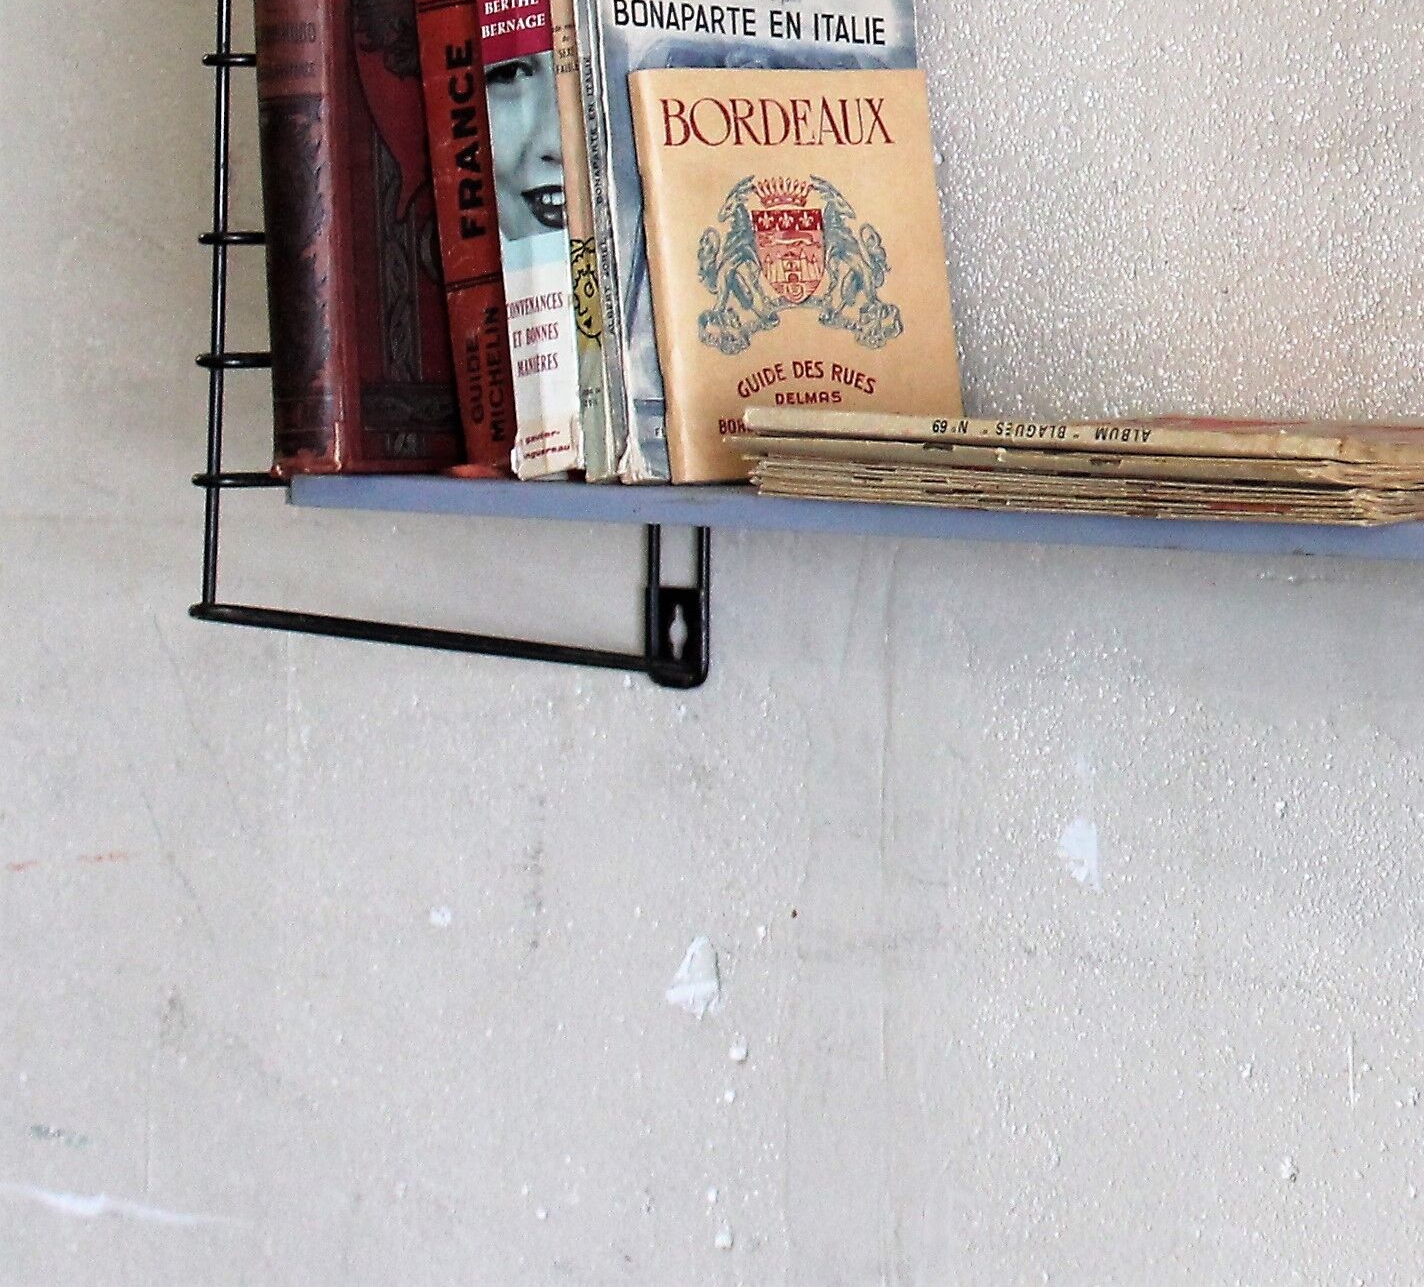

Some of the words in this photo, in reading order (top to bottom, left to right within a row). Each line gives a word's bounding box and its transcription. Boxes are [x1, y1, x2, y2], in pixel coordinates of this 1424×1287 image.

[481, 13, 546, 39] BERNAGE
[769, 10, 801, 40] EN
[813, 13, 886, 45] ITALIE
[660, 96, 895, 146] BORDEAUX
[445, 40, 486, 239] FRANCE
[589, 129, 604, 206] BONAPARTE
[513, 331, 522, 348] ET
[526, 322, 559, 345] BONNES
[465, 338, 485, 424] GUIDE
[485, 306, 506, 442] MICHELIN
[517, 352, 559, 377] MANIÈRES
[737, 363, 786, 398] GUIDE
[792, 360, 824, 379] DES
[831, 364, 877, 395] RUES
[775, 391, 842, 405] DELMAS
[932, 420, 948, 434] 69
[1094, 426, 1151, 443] ALBUM
